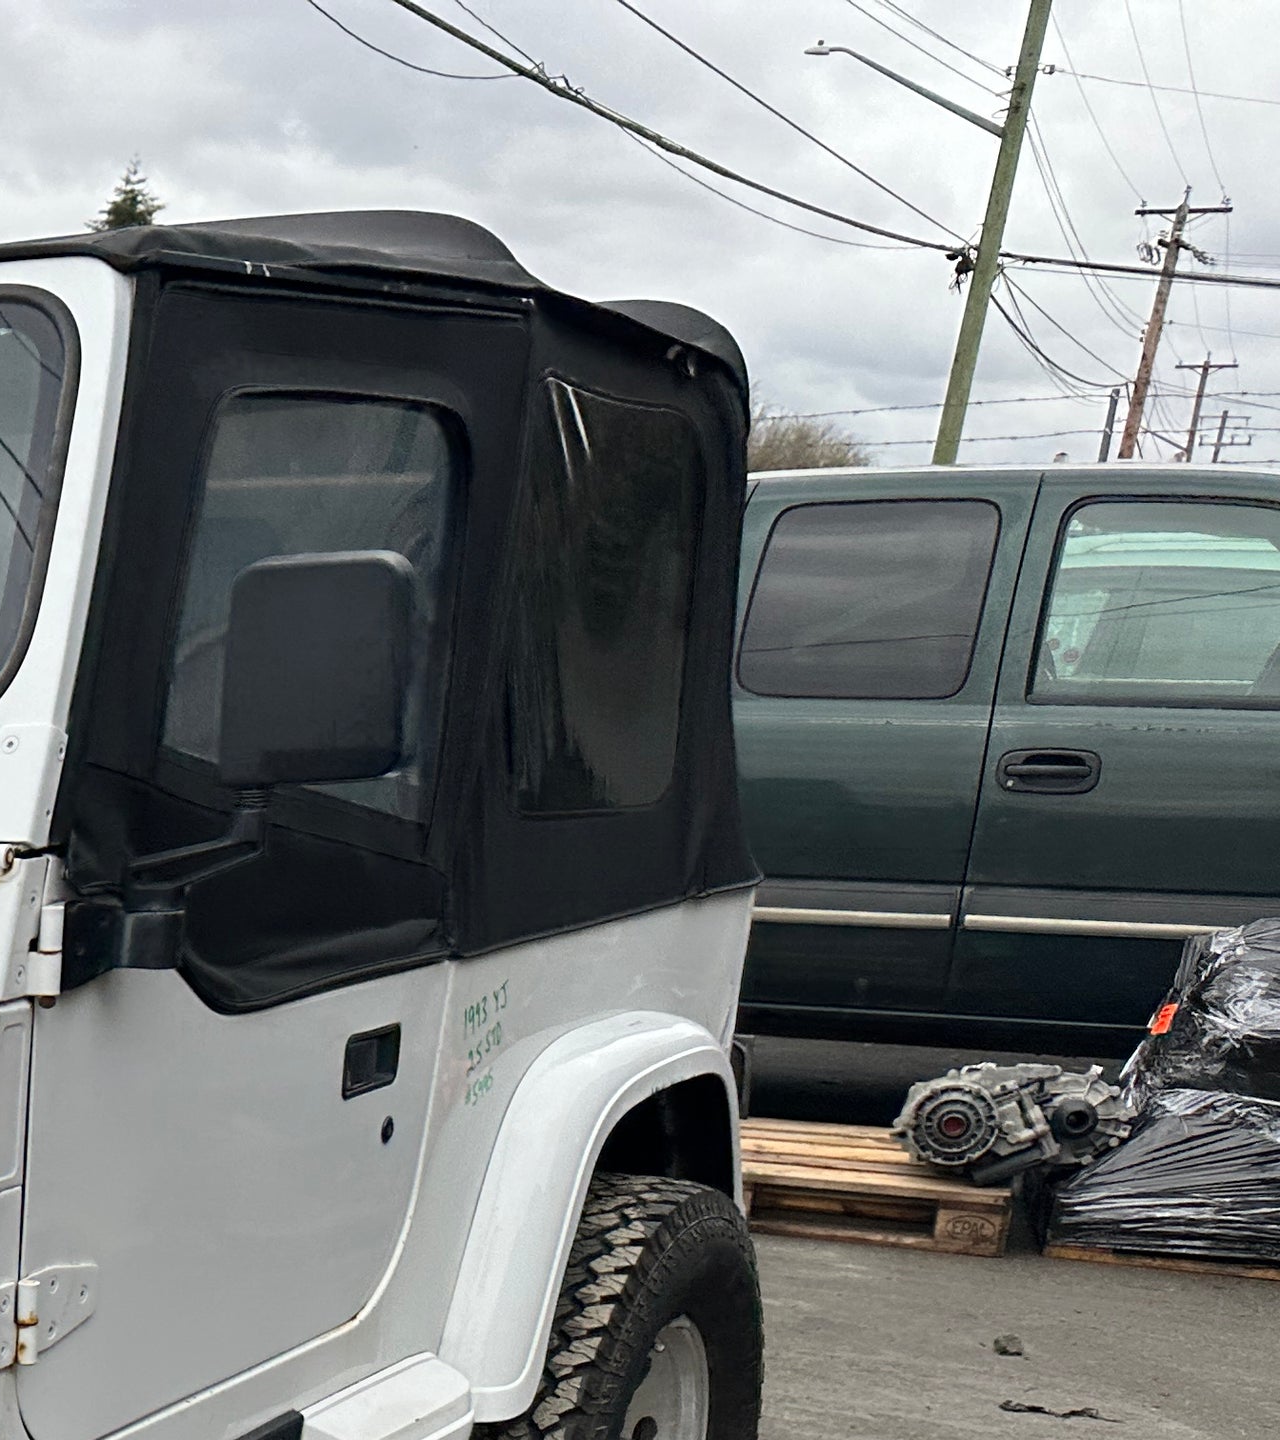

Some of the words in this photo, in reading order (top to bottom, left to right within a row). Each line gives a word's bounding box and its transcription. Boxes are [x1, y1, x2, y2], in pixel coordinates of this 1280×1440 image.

[463, 995, 487, 1041] 1993
[493, 979, 509, 1012] YJ
[952, 1219, 990, 1240] EPAL
